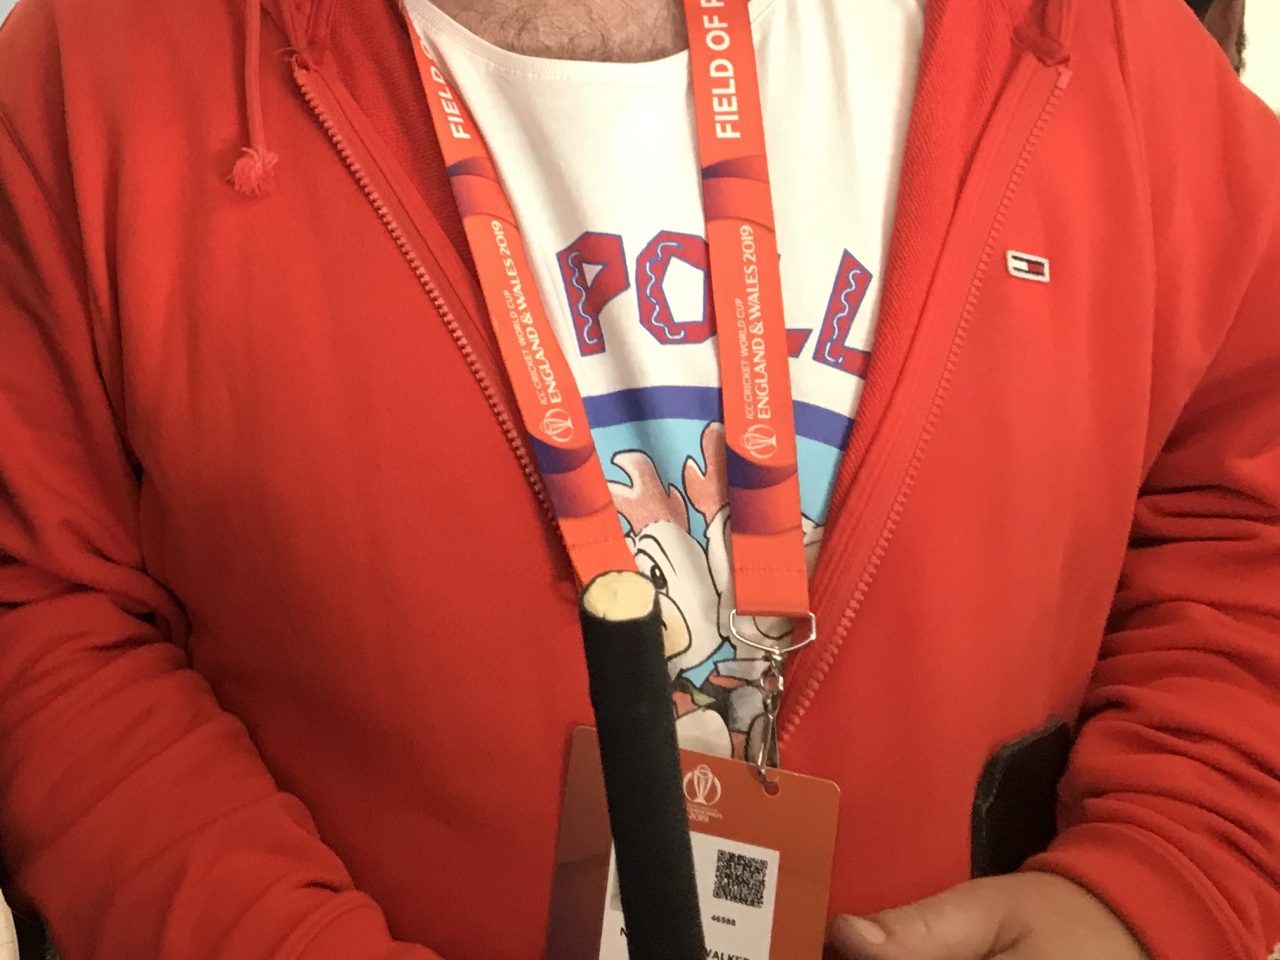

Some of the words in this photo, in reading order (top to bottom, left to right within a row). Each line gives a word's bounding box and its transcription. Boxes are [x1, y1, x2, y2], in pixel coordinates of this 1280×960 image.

[702, 14, 732, 52] OF
[430, 65, 472, 140] FIELD
[708, 58, 742, 140] FIELD
[491, 219, 512, 258] 2019
[740, 224, 757, 264] 2019
[502, 289, 516, 312] CUP
[503, 258, 528, 311] WALES
[745, 264, 763, 319] WALES
[510, 312, 528, 344] WORLD
[521, 311, 534, 326] &
[735, 297, 745, 319] CUP
[748, 320, 765, 336] &
[737, 319, 750, 358] WORLD
[522, 348, 545, 391] CRICKET
[527, 327, 563, 404] ENGLAND
[740, 358, 753, 403] CRICKET
[751, 336, 771, 420] ENGLAND
